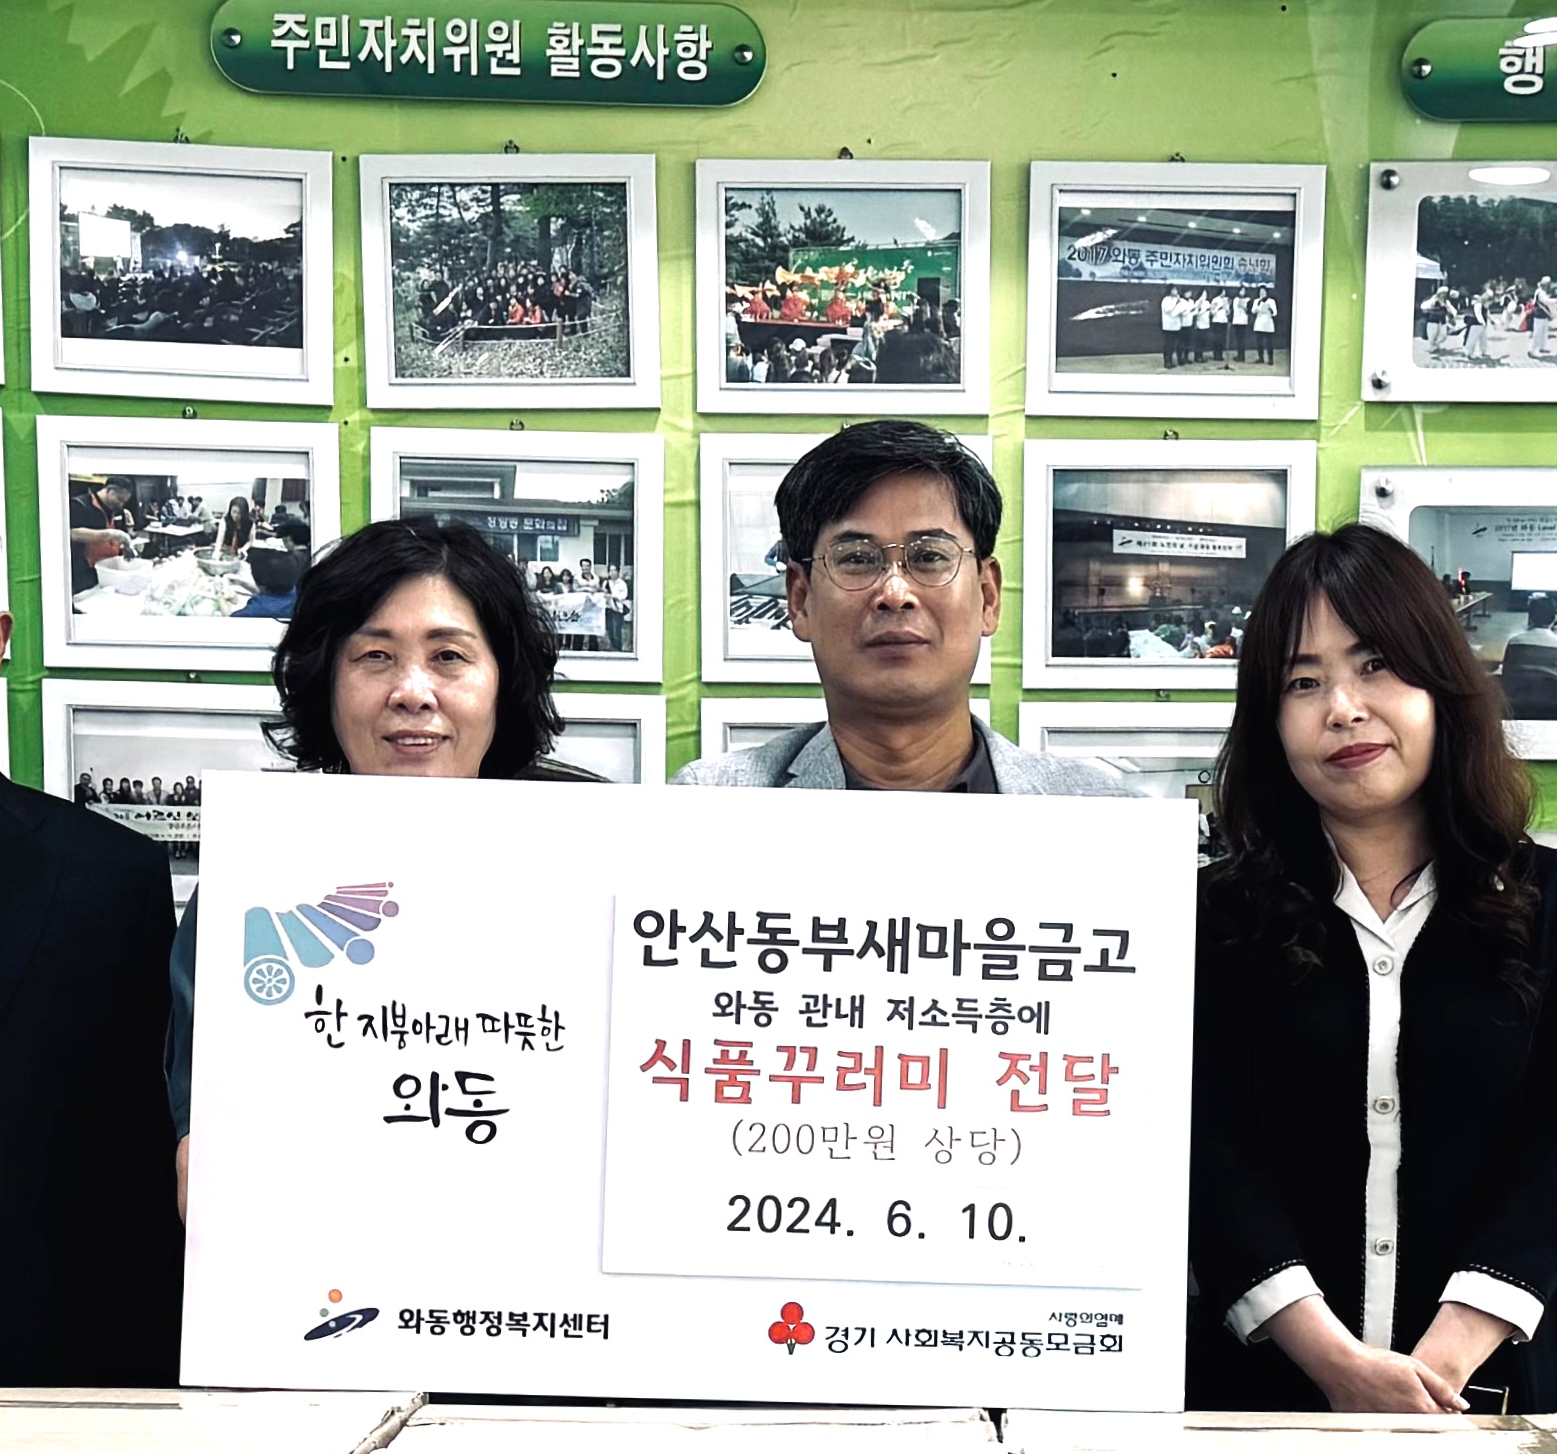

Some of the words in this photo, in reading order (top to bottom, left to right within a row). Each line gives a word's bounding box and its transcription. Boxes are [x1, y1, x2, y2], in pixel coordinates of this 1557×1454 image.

[268, 13, 523, 77] 주민자치위원
[546, 20, 713, 82] 활동사항
[1112, 247, 1141, 266] 와동
[633, 909, 1136, 981] 안산동부새마을금고
[304, 984, 348, 1048] 한
[357, 1000, 468, 1050] 지붕아래
[476, 1004, 565, 1052] 따뜻한
[712, 991, 779, 1028] 와동
[799, 994, 865, 1028] 관내
[887, 997, 1050, 1035] 저소득층에
[640, 1039, 949, 1109] 식품꾸러미
[996, 1052, 1119, 1117] 전달
[383, 1071, 510, 1144] 와동
[732, 1119, 895, 1160] (200만원
[925, 1126, 1021, 1165] 상당)
[727, 1195, 854, 1237] 2024.
[887, 1200, 925, 1238] 6.
[962, 1202, 1026, 1242] 10.
[398, 1309, 609, 1339] 와동행정복지센터
[826, 1326, 875, 1353] 경기
[886, 1329, 1122, 1357] 사회복지공동모금회
